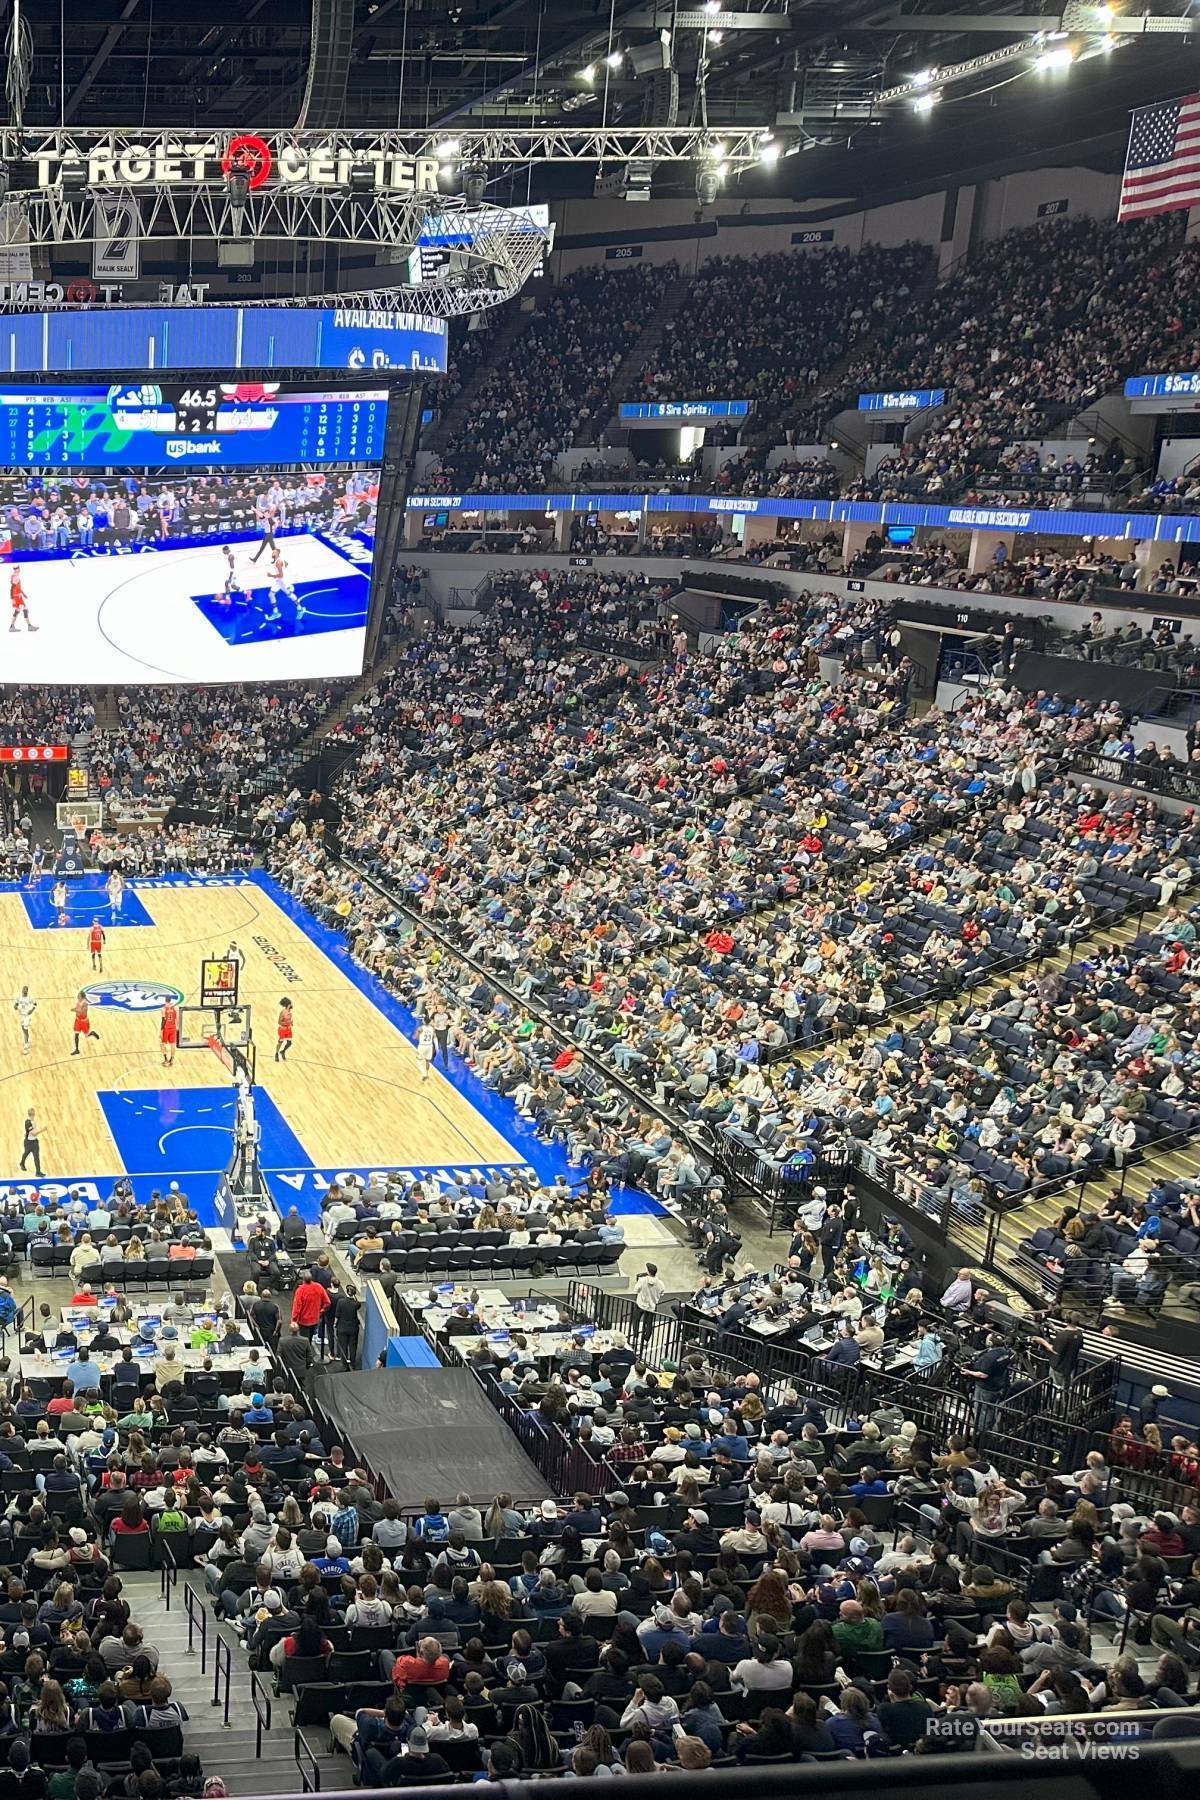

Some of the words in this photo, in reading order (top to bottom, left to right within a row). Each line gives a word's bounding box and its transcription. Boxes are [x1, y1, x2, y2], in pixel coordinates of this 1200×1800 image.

[1045, 202, 1059, 214] 207
[803, 232, 822, 242] 206
[615, 248, 632, 258] 205
[334, 309, 394, 329] AVAILABLE
[178, 389, 217, 407] 46.5
[320, 404, 327, 412] 3
[337, 404, 343, 412] 3
[353, 403, 359, 411] 0
[370, 403, 375, 411] 0
[666, 405, 681, 415] Sire
[682, 404, 707, 417] Spirits
[319, 415, 327, 424] 12
[336, 415, 342, 423] 2
[352, 415, 358, 423] 3
[369, 414, 374, 422] 0
[178, 420, 186, 431] 6
[191, 418, 201, 432] 2
[206, 420, 214, 431] 4
[318, 427, 327, 435] 15
[351, 426, 357, 434] 2
[368, 425, 373, 433] 2
[27, 442, 34, 450] 5
[63, 442, 68, 450] 1
[318, 438, 324, 446] 6
[334, 437, 340, 445] 3
[367, 436, 372, 444] 0
[316, 448, 325, 456] 15
[335, 448, 338, 456] 1
[350, 447, 356, 455] 4
[27, 453, 34, 461] 9
[45, 453, 51, 461] 3
[62, 453, 68, 461] 3
[430, 496, 452, 507] SECTION
[957, 613, 968, 623] 110
[124, 879, 258, 889] INNESOTA
[251, 935, 279, 955] CENTER
[273, 961, 303, 983] TARGET
